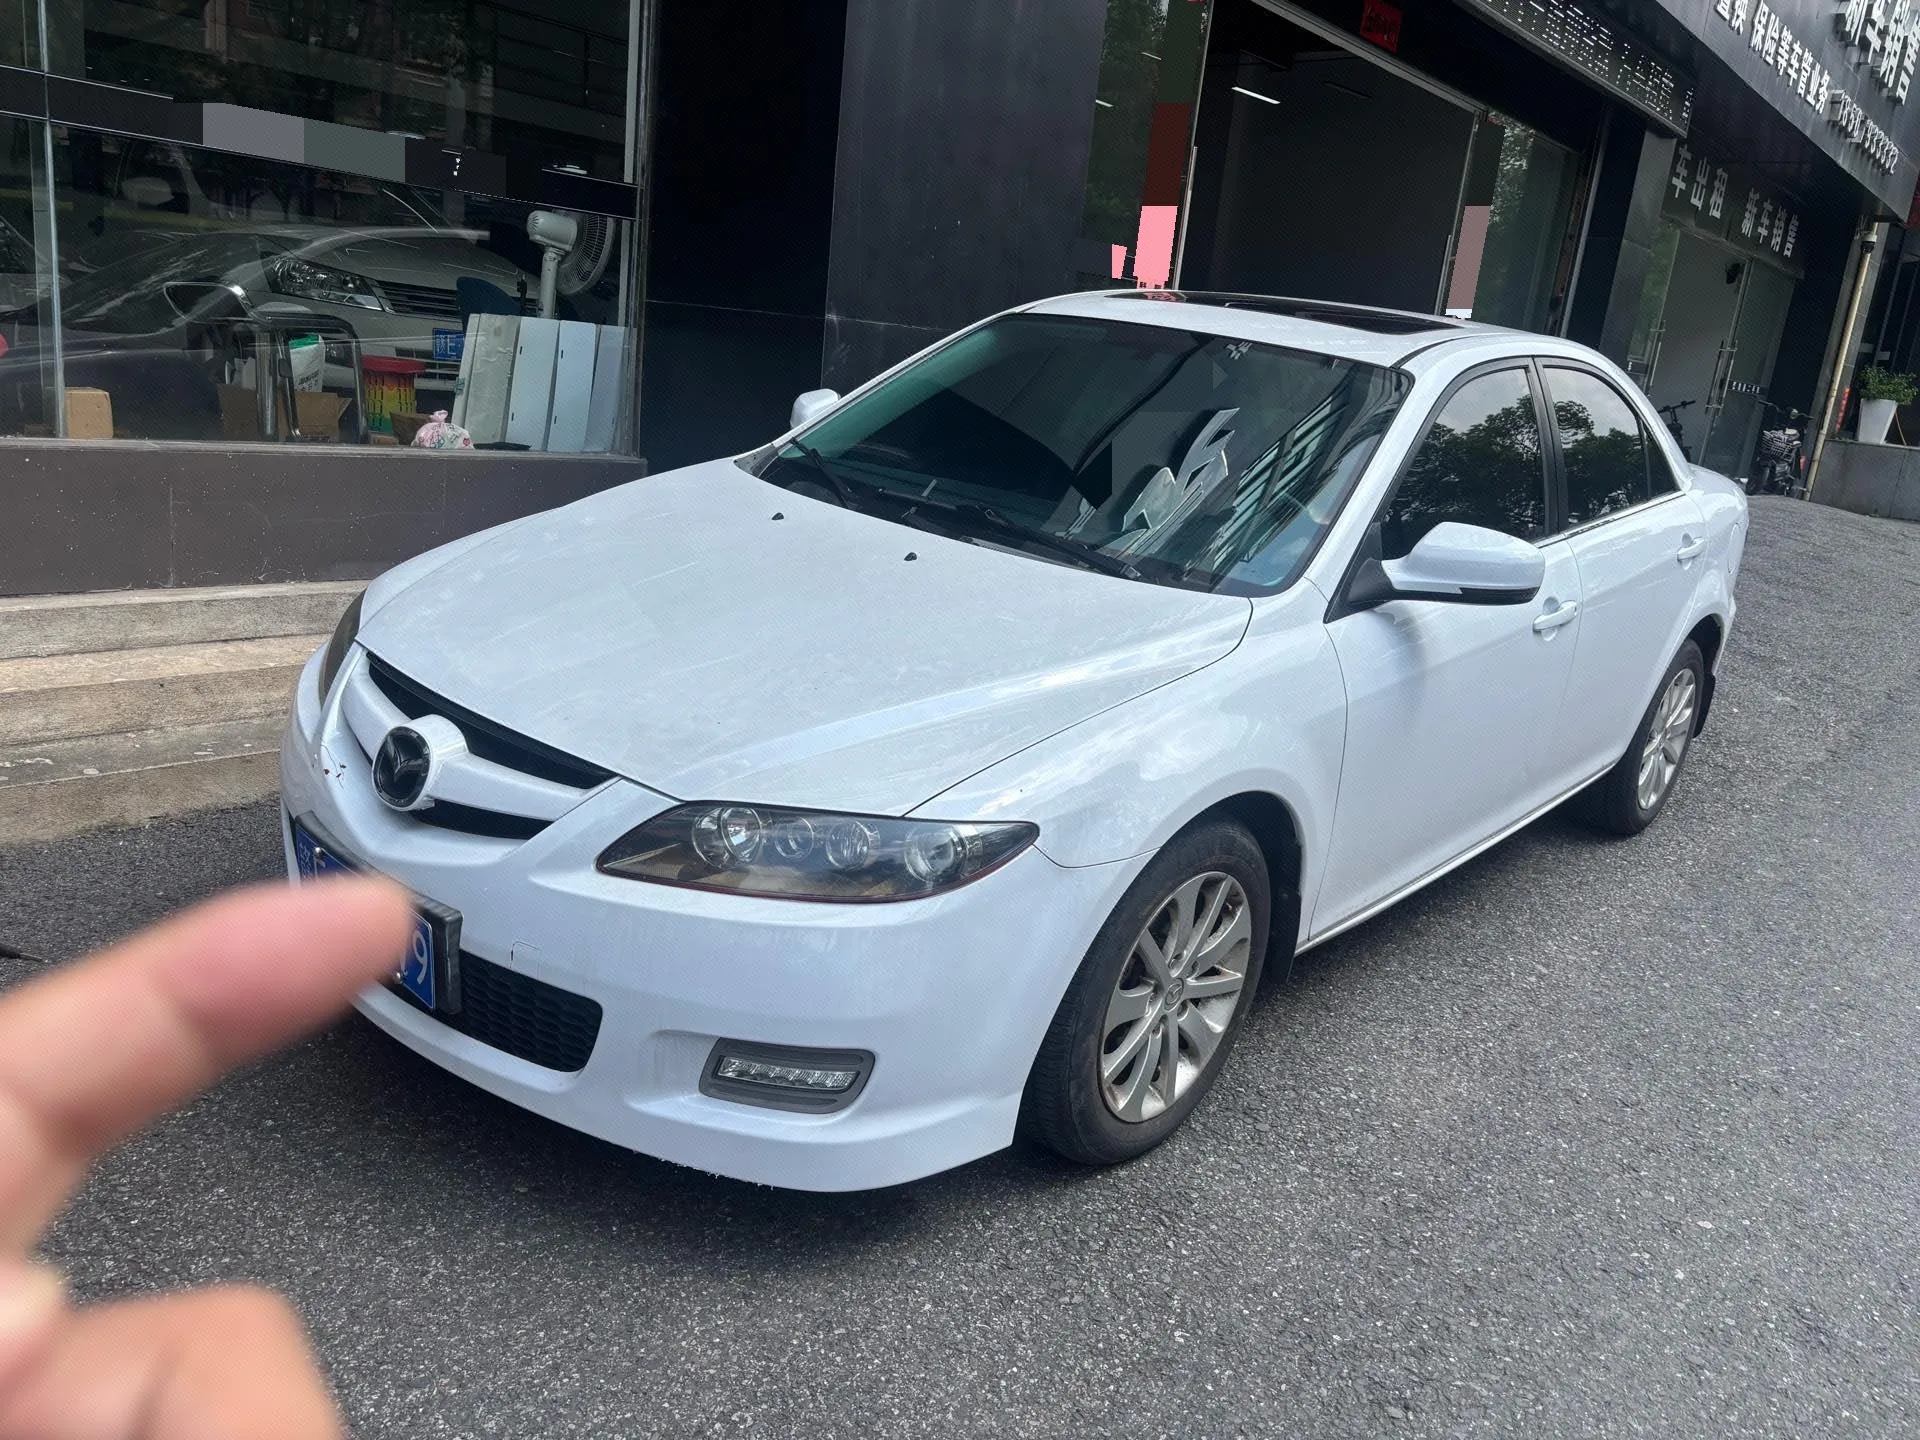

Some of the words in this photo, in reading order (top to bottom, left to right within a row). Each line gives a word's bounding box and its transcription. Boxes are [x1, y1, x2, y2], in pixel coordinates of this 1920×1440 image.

[1749, 0, 1830, 115] 保险等车管业务
[1671, 144, 1728, 219] 车出租
[1741, 187, 1799, 258] 新车销售
